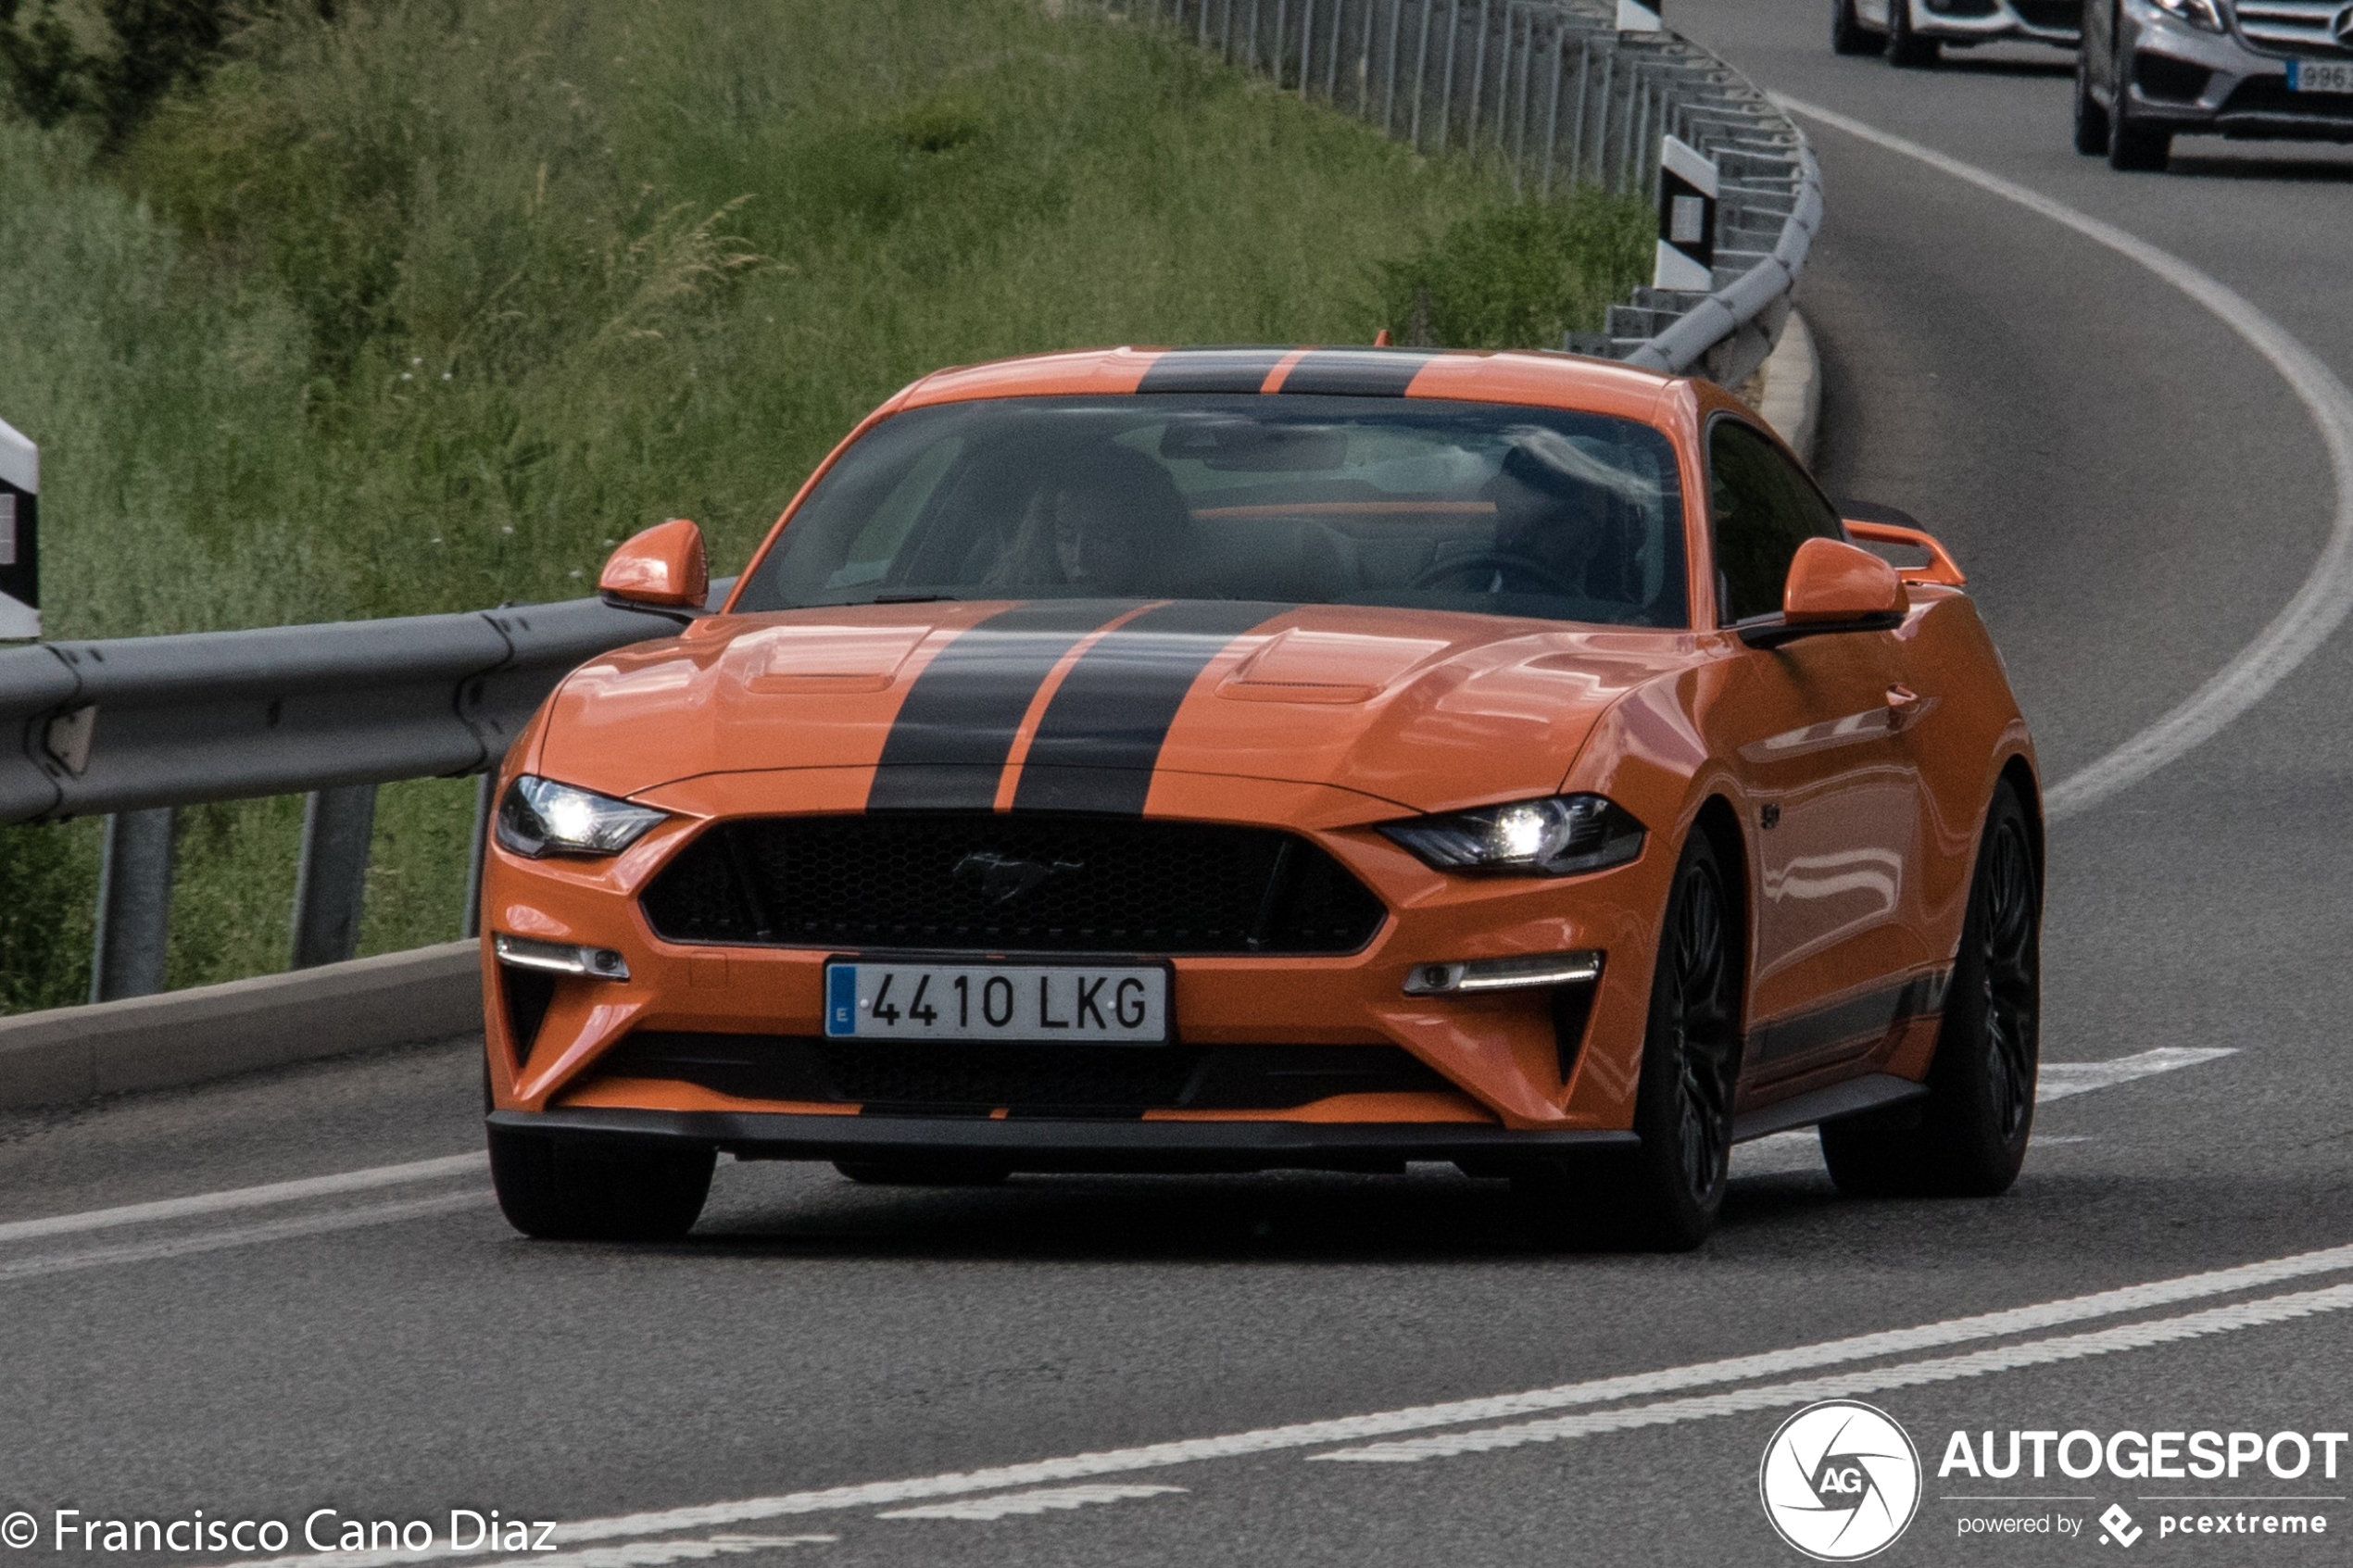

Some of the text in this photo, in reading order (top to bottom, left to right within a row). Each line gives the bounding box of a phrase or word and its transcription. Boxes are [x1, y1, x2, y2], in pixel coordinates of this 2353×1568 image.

[837, 1010, 849, 1022] E
[872, 974, 1145, 1030] 4410 LKG
